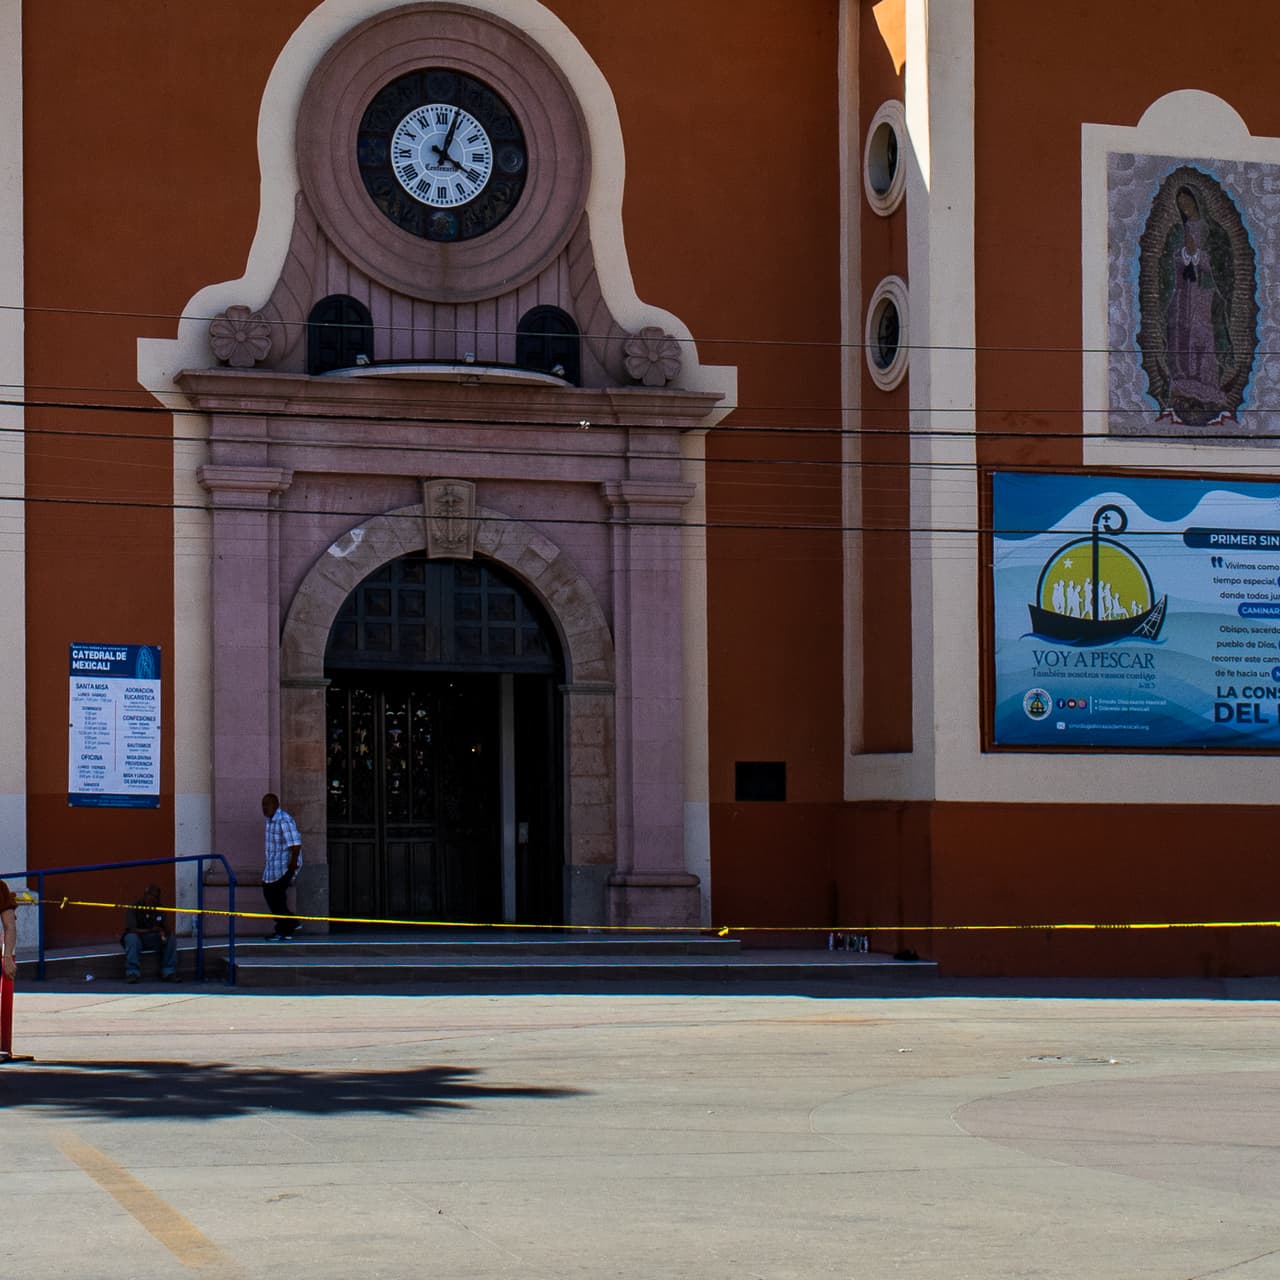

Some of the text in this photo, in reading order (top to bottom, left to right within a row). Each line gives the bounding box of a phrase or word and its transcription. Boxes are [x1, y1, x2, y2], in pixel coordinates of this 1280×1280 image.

[1210, 534, 1257, 546] PRIMER
[1213, 576, 1242, 586] tiempo
[1220, 591, 1246, 600] donde
[1246, 591, 1269, 600] todos
[1241, 606, 1280, 615] CAMINAR
[1219, 625, 1249, 635] Obispo,
[1216, 640, 1244, 649] pueblo
[1246, 641, 1256, 649] de
[1257, 641, 1277, 650] Dios,
[72, 650, 127, 661] CATEDRAL DE
[1032, 650, 1155, 669] VOY A PESCAR
[1244, 656, 1262, 664] este
[72, 661, 111, 671] MEXICALI
[1126, 672, 1156, 681] contigo
[1215, 669, 1226, 677] de
[1227, 669, 1236, 677] fe
[1236, 670, 1258, 678] hacia
[1217, 686, 1238, 699] LA
[1214, 703, 1269, 724] DEL
